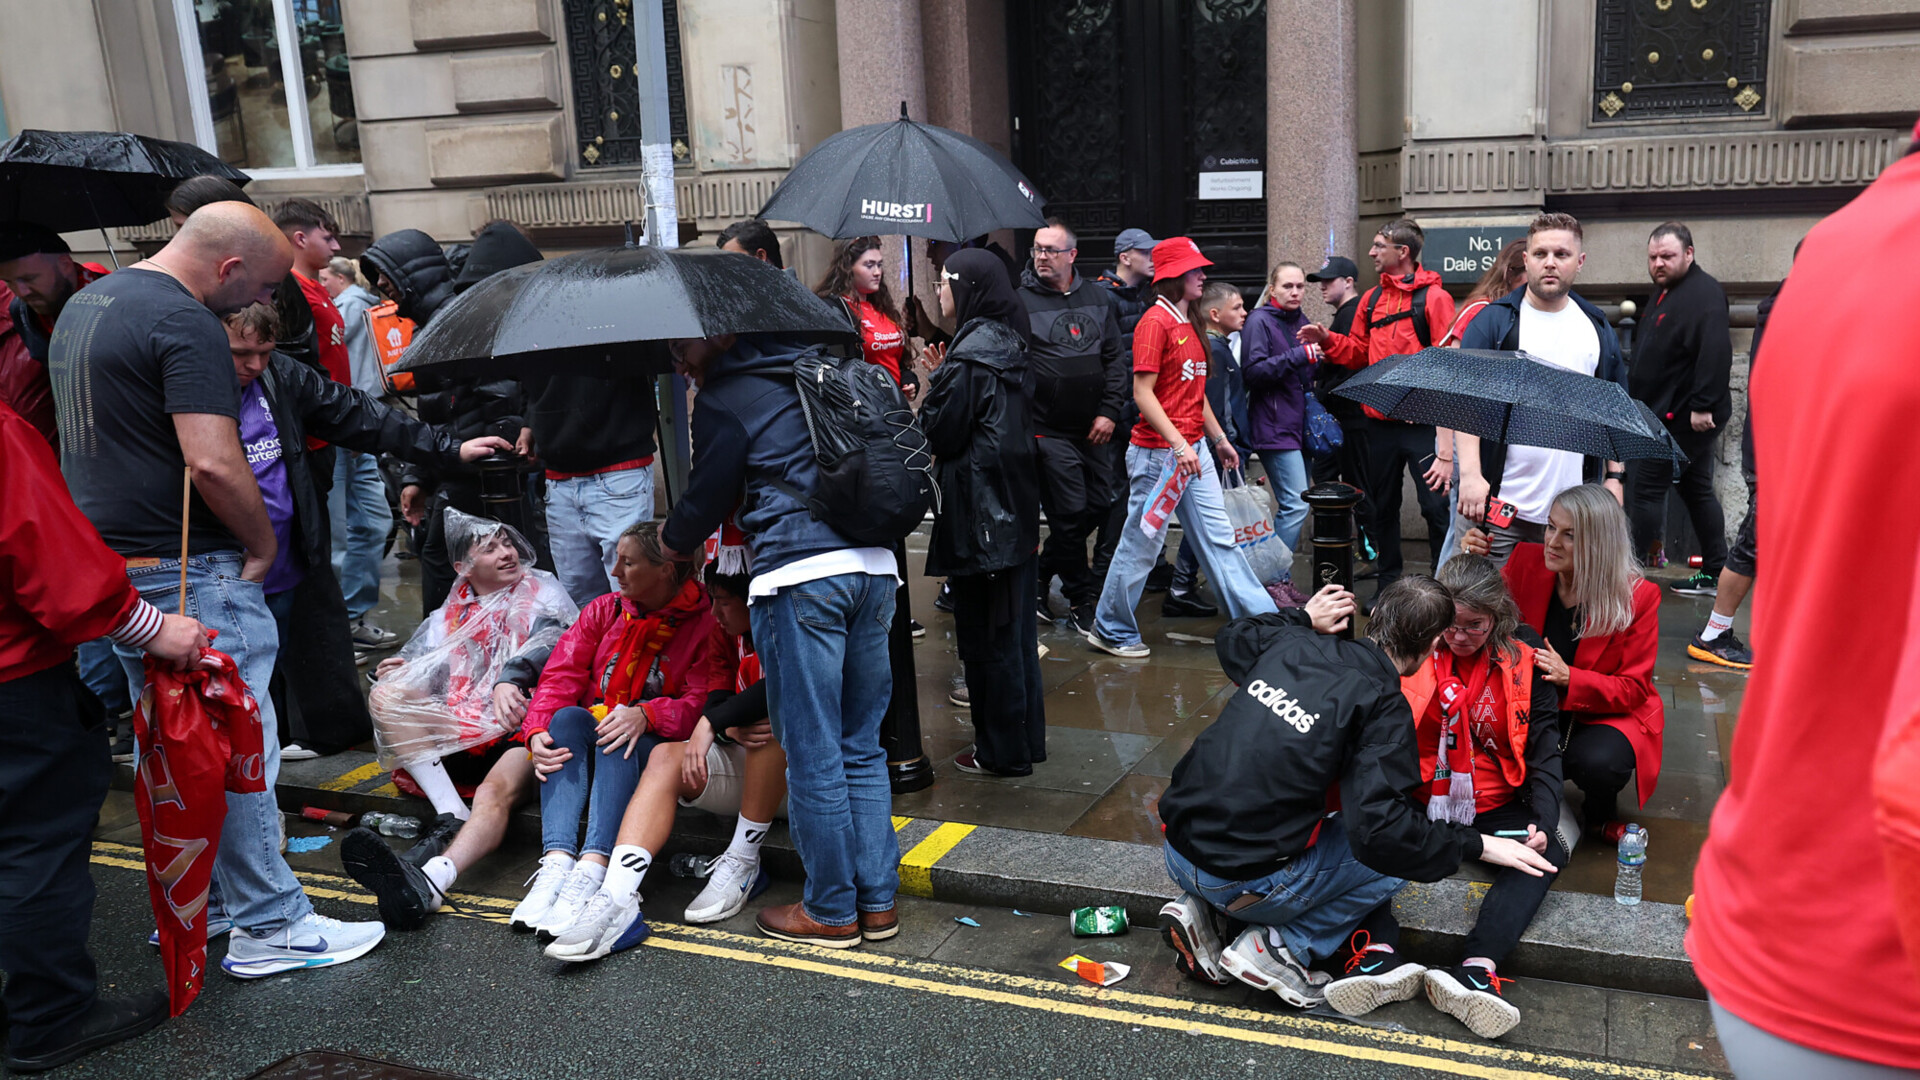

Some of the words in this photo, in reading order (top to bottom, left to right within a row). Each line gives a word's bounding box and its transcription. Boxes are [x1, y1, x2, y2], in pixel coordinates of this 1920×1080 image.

[861, 199, 925, 218] HURST
[1443, 256, 1477, 271] Dale
[1481, 256, 1496, 271] S
[70, 292, 116, 308] REEDOM
[1247, 679, 1316, 734] adidas
